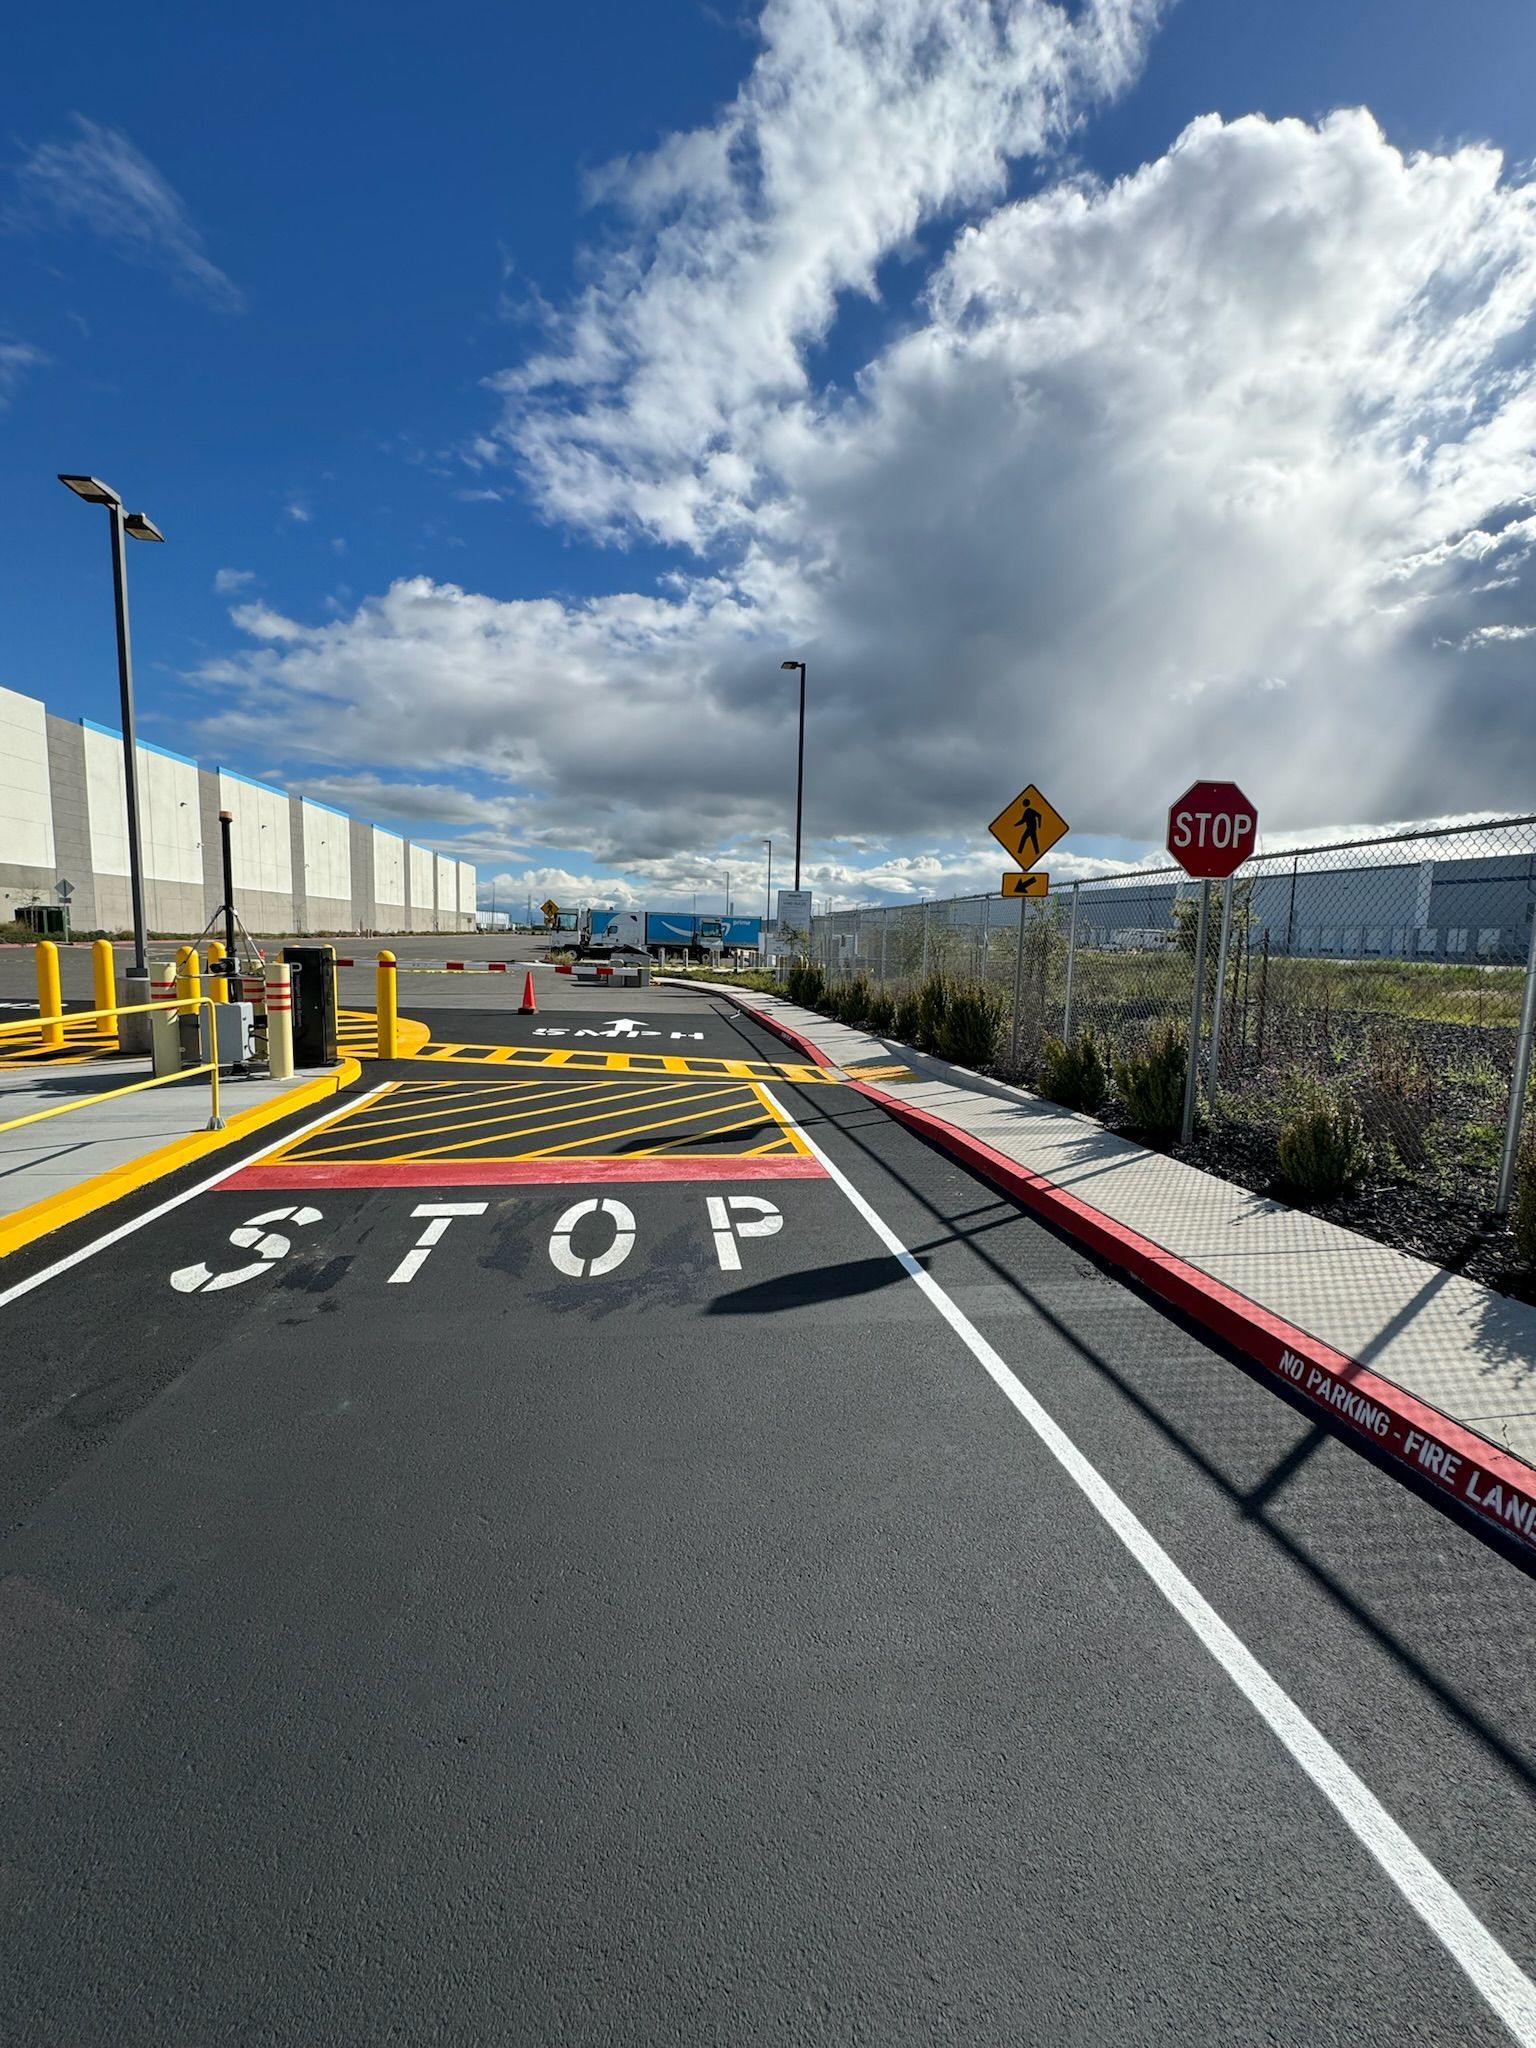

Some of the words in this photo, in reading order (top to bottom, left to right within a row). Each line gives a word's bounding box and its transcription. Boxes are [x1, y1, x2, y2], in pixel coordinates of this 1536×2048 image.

[1174, 812, 1252, 849] STOP
[732, 919, 752, 927] prime
[169, 1195, 784, 1294] STOP
[1279, 1350, 1305, 1381] NO
[1306, 1368, 1390, 1436] PARKING
[1404, 1431, 1462, 1485] FIRE
